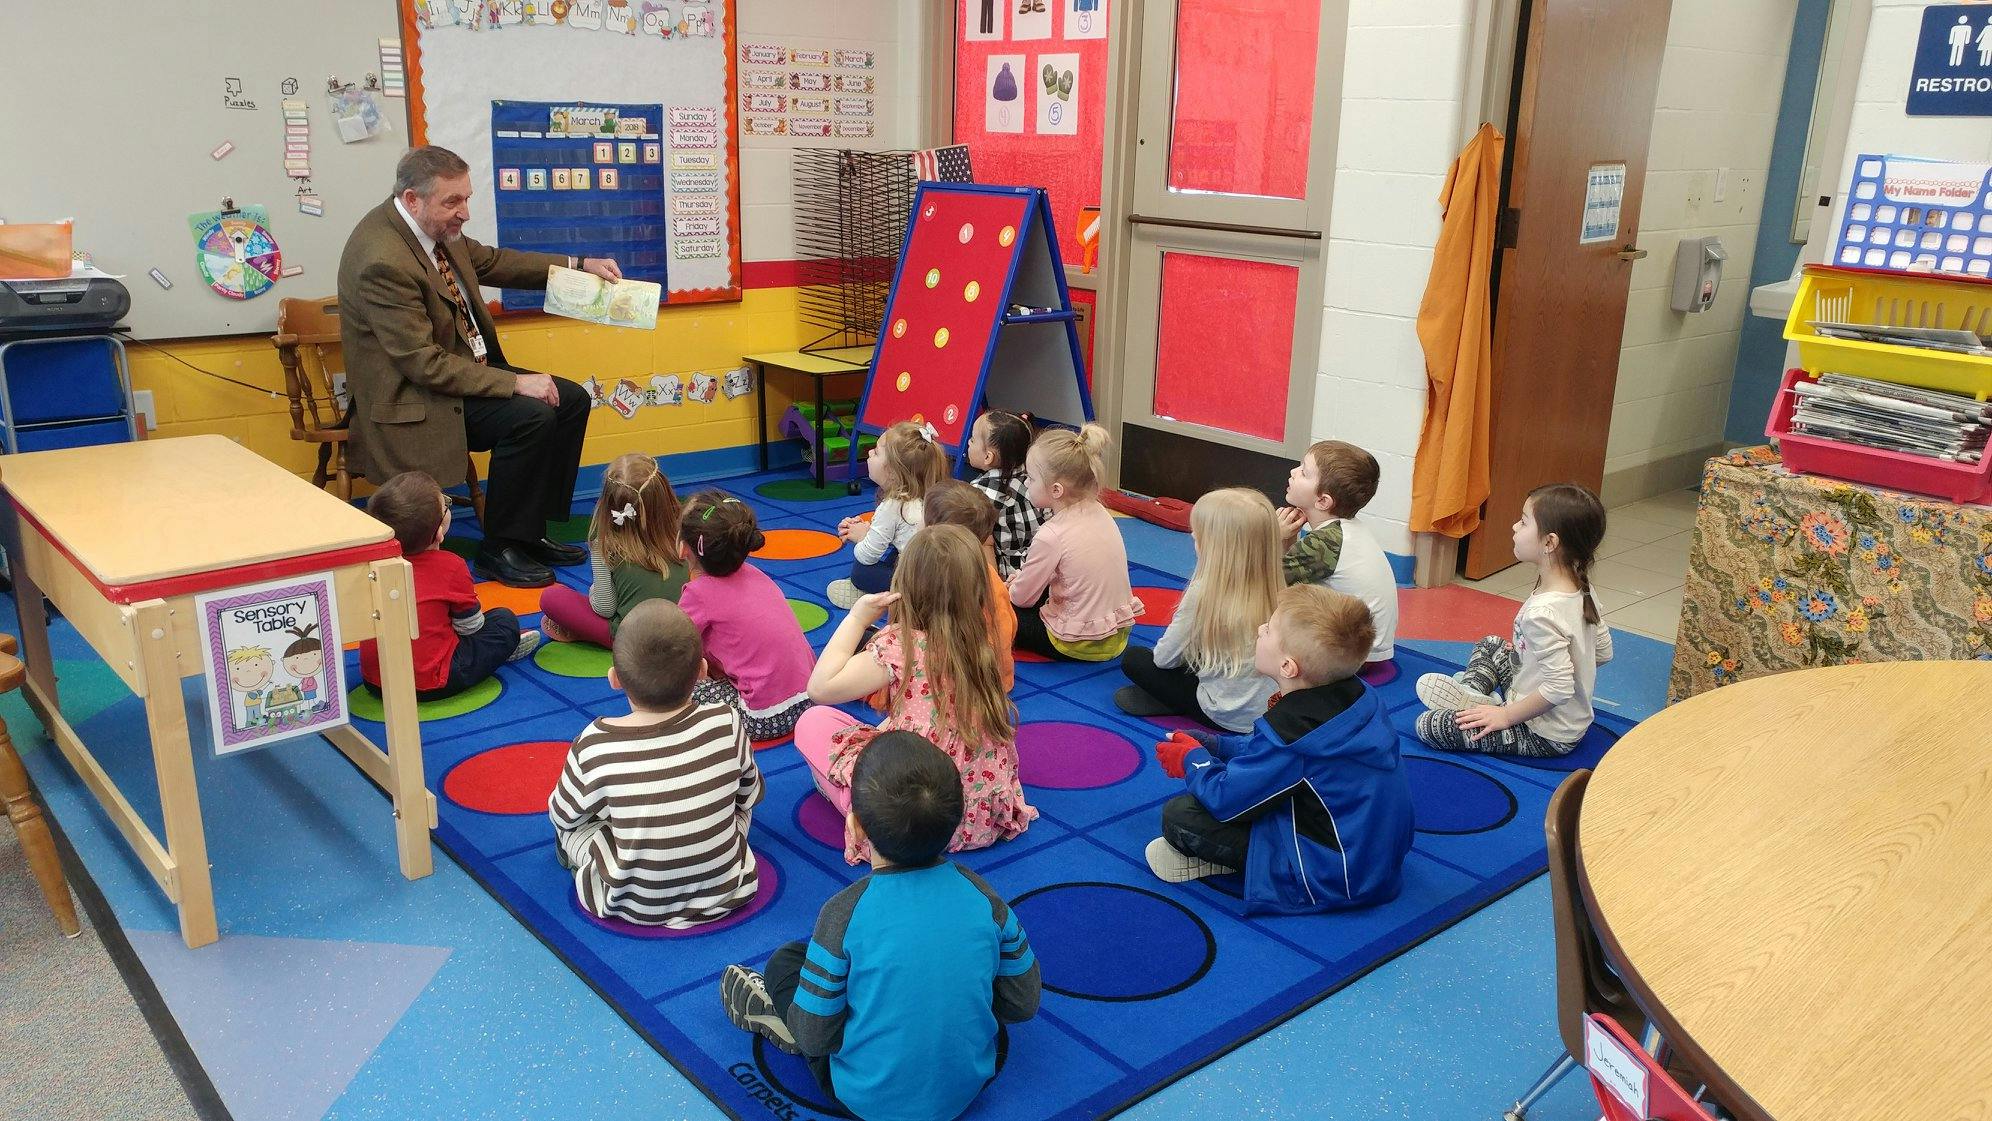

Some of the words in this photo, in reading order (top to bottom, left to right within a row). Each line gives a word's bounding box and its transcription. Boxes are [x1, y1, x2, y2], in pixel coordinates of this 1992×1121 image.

[576, 3, 600, 18] Mm
[609, 6, 627, 24] Nn
[646, 12, 664, 27] Oo
[687, 13, 703, 35] Pp
[752, 48, 777, 59] January
[796, 52, 822, 61] February
[844, 55, 864, 63] March
[757, 75, 773, 84] April
[803, 77, 817, 86] May
[1915, 77, 1992, 92] RESTRO
[223, 95, 256, 109] Puzzles
[759, 99, 772, 108] July
[799, 100, 822, 109] August
[570, 116, 600, 126] March
[679, 112, 708, 123] Sunday
[624, 123, 639, 132] 2018
[679, 133, 708, 143] Monday
[601, 148, 607, 158] 1
[624, 148, 630, 158] 2
[649, 148, 655, 158] 3
[679, 155, 710, 166] Tuesday
[506, 174, 513, 184] 4
[534, 174, 540, 184] 5
[559, 173, 565, 184] 6
[577, 173, 583, 184] 7
[605, 174, 612, 184] 8
[297, 185, 312, 194] Art
[1883, 185, 1901, 197] My
[1904, 186, 1937, 197] Name
[1939, 187, 1975, 198] Folder
[679, 201, 713, 211] Thursday
[195, 218, 211, 231] The
[685, 222, 709, 232] Friday
[680, 244, 715, 253] Saturday
[928, 271, 938, 283] 10
[896, 322, 903, 334] 5
[658, 383, 674, 396] Xx
[947, 408, 954, 420] 2
[233, 600, 307, 624] Sensory
[253, 615, 297, 634] Table
[1593, 1041, 1640, 1098] Jeremiah
[728, 1062, 800, 1121] Carpets
